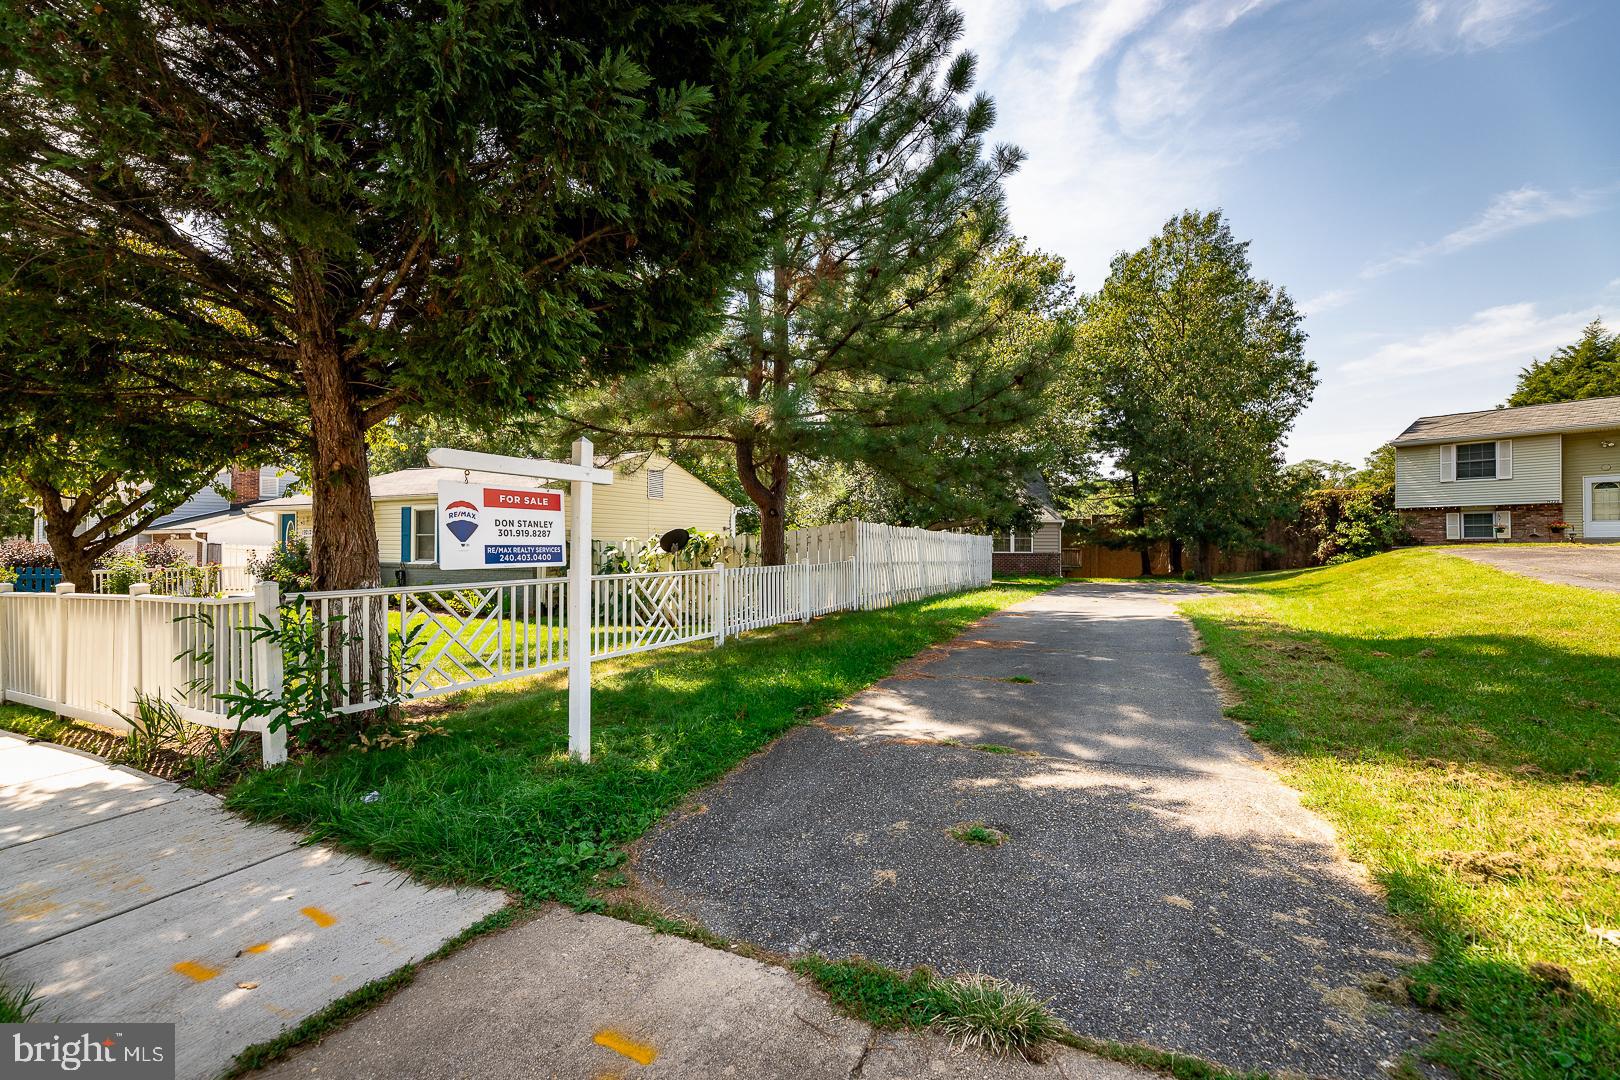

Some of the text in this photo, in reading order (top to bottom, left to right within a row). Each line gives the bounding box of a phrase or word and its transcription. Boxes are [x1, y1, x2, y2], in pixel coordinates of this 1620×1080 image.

[500, 494, 549, 506] FOR SALE
[448, 511, 476, 520] RE/MAX
[494, 519, 554, 528] DON STANLEY
[498, 530, 551, 538] 301.919.8287
[487, 546, 512, 554] RE/MAX
[499, 553, 552, 562] 240.403.0400
